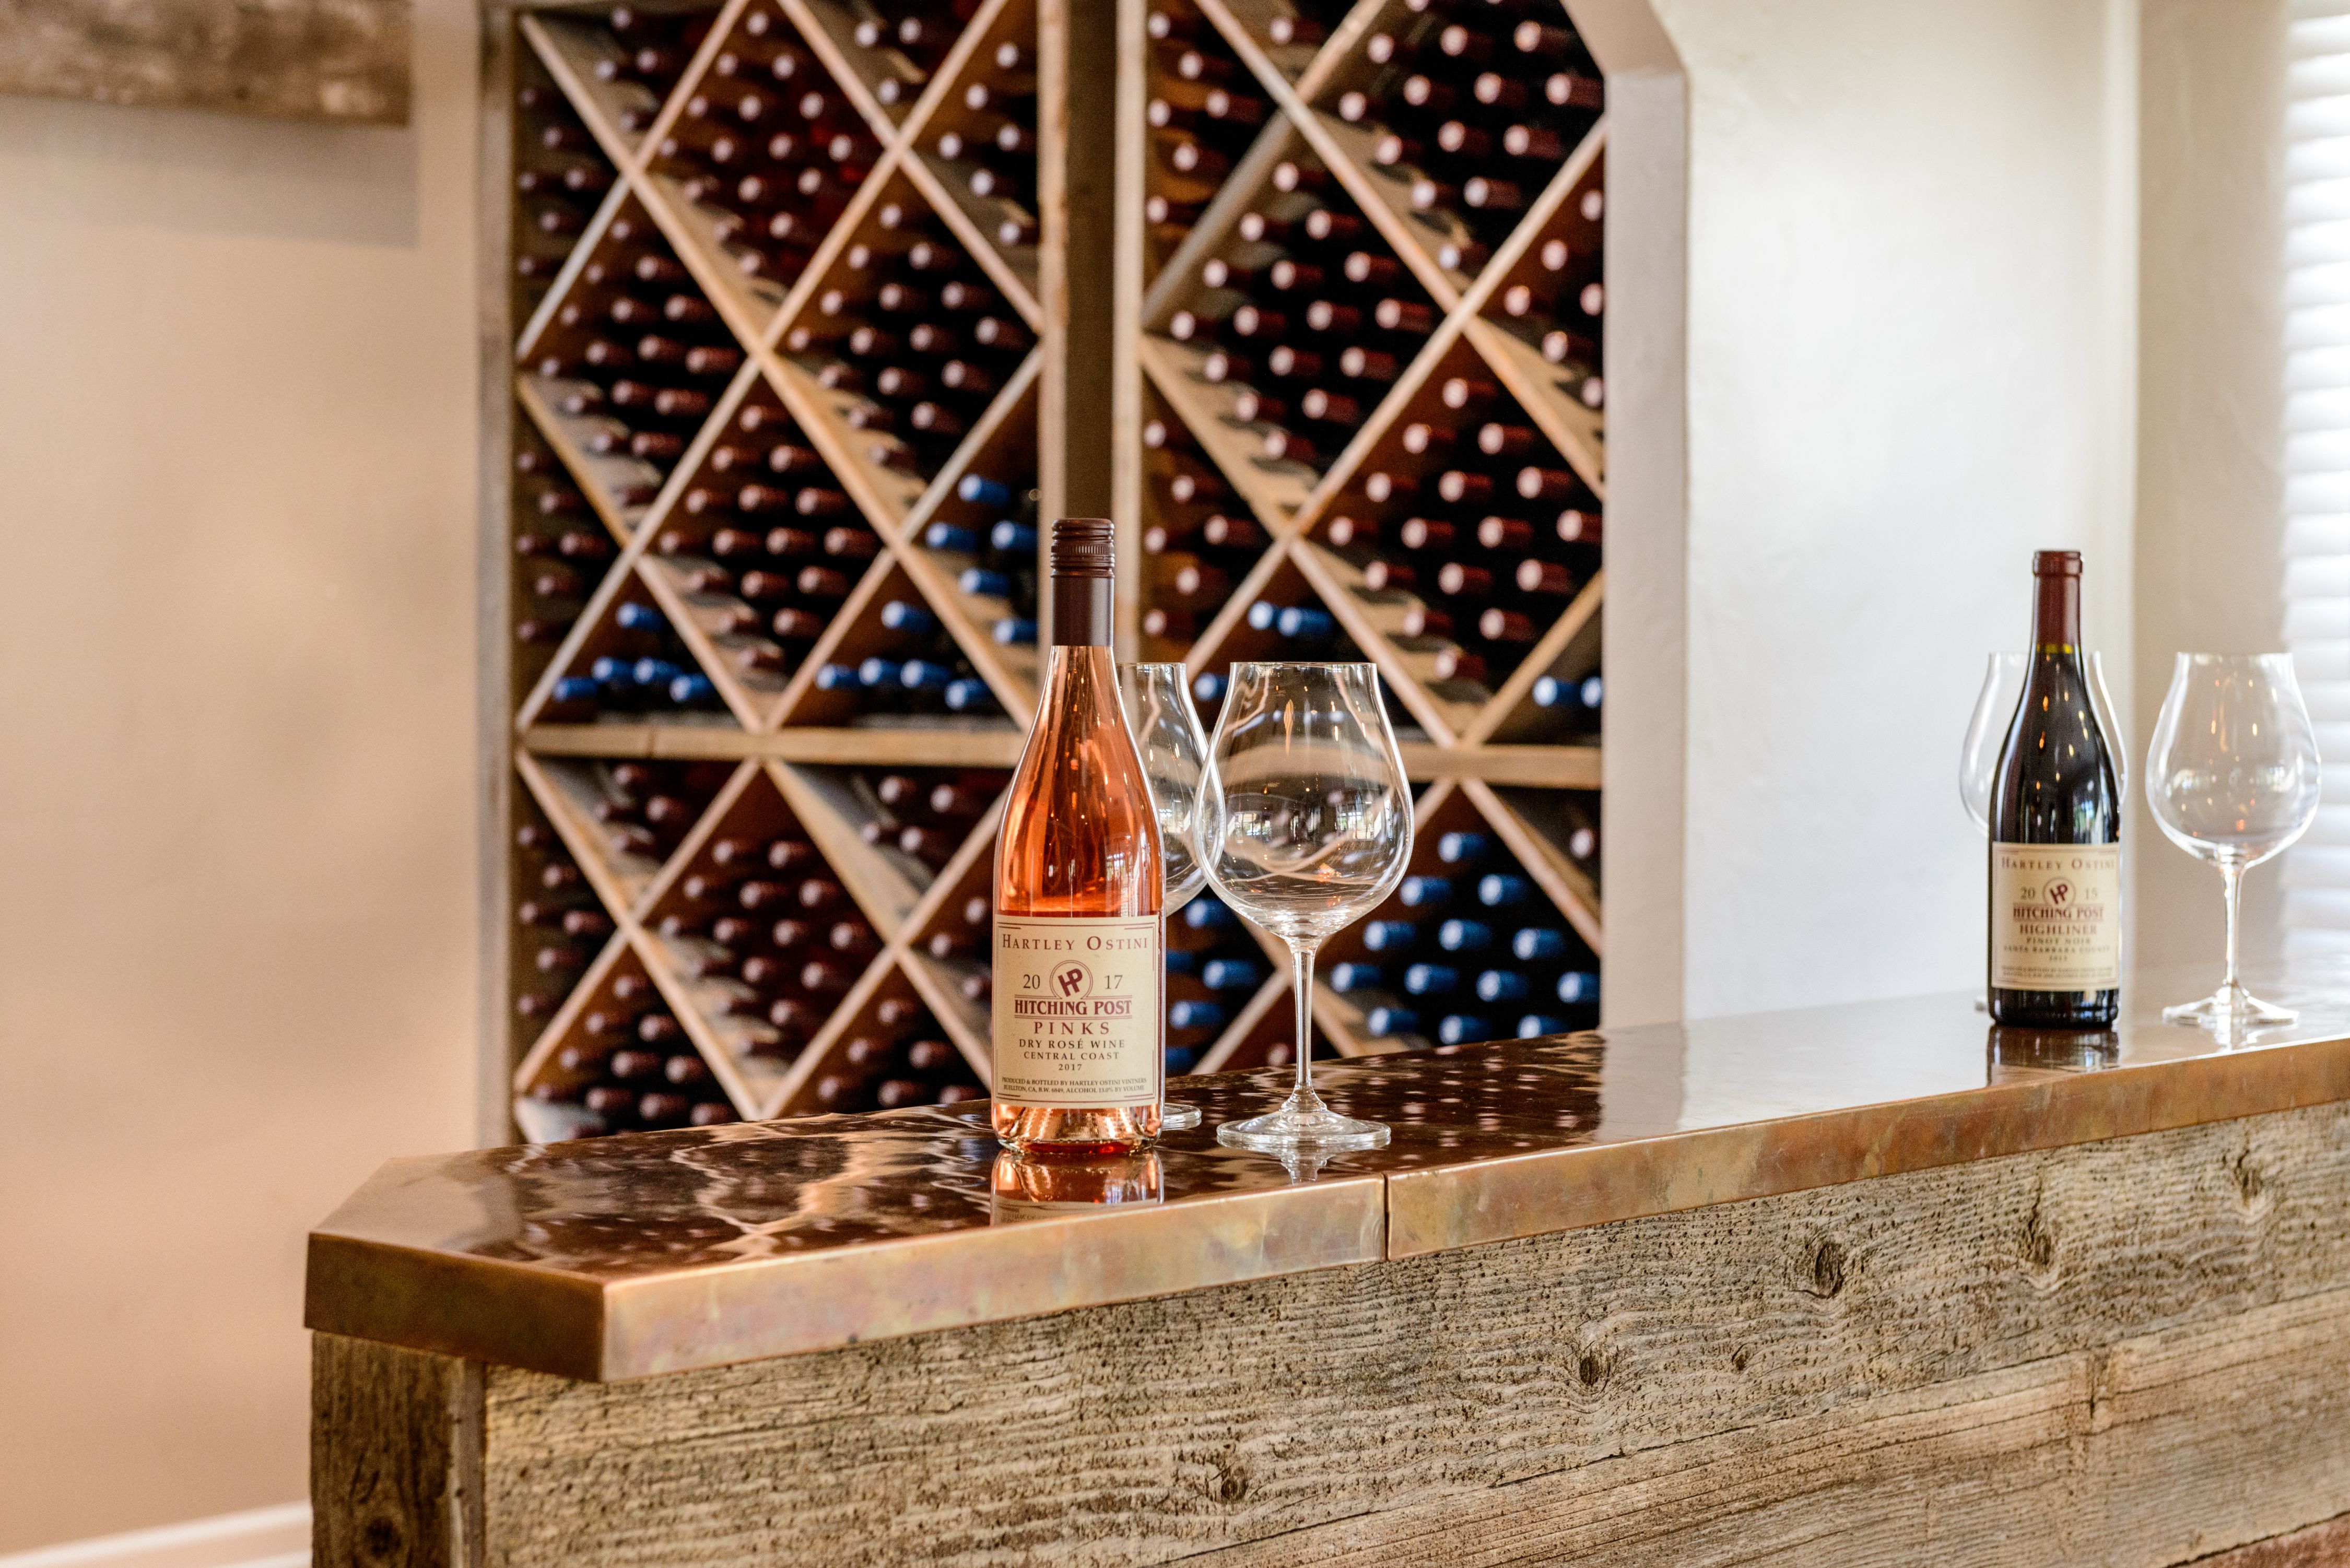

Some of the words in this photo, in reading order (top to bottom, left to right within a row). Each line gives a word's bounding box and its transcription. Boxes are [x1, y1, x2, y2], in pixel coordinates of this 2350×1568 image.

[2002, 856, 2062, 870] HARTLEY
[2072, 857, 2114, 870] OSTINI
[2013, 906, 2071, 919] HITCHING
[2076, 907, 2103, 919] POST
[2020, 924, 2097, 935] HIGHLINER
[1002, 934, 1075, 950] HARTLEY
[1087, 936, 1148, 950] OSTINI
[1023, 974, 1040, 989] 20
[1104, 975, 1123, 989] 17
[1015, 999, 1087, 1015] HITCHING
[1095, 1000, 1132, 1015] POST
[1034, 1022, 1110, 1035] PINKS
[1019, 1039, 1042, 1048] DRY
[1049, 1039, 1084, 1049] ROSÉ
[1090, 1040, 1125, 1048] WINE
[1024, 1052, 1075, 1060] CENTRAL
